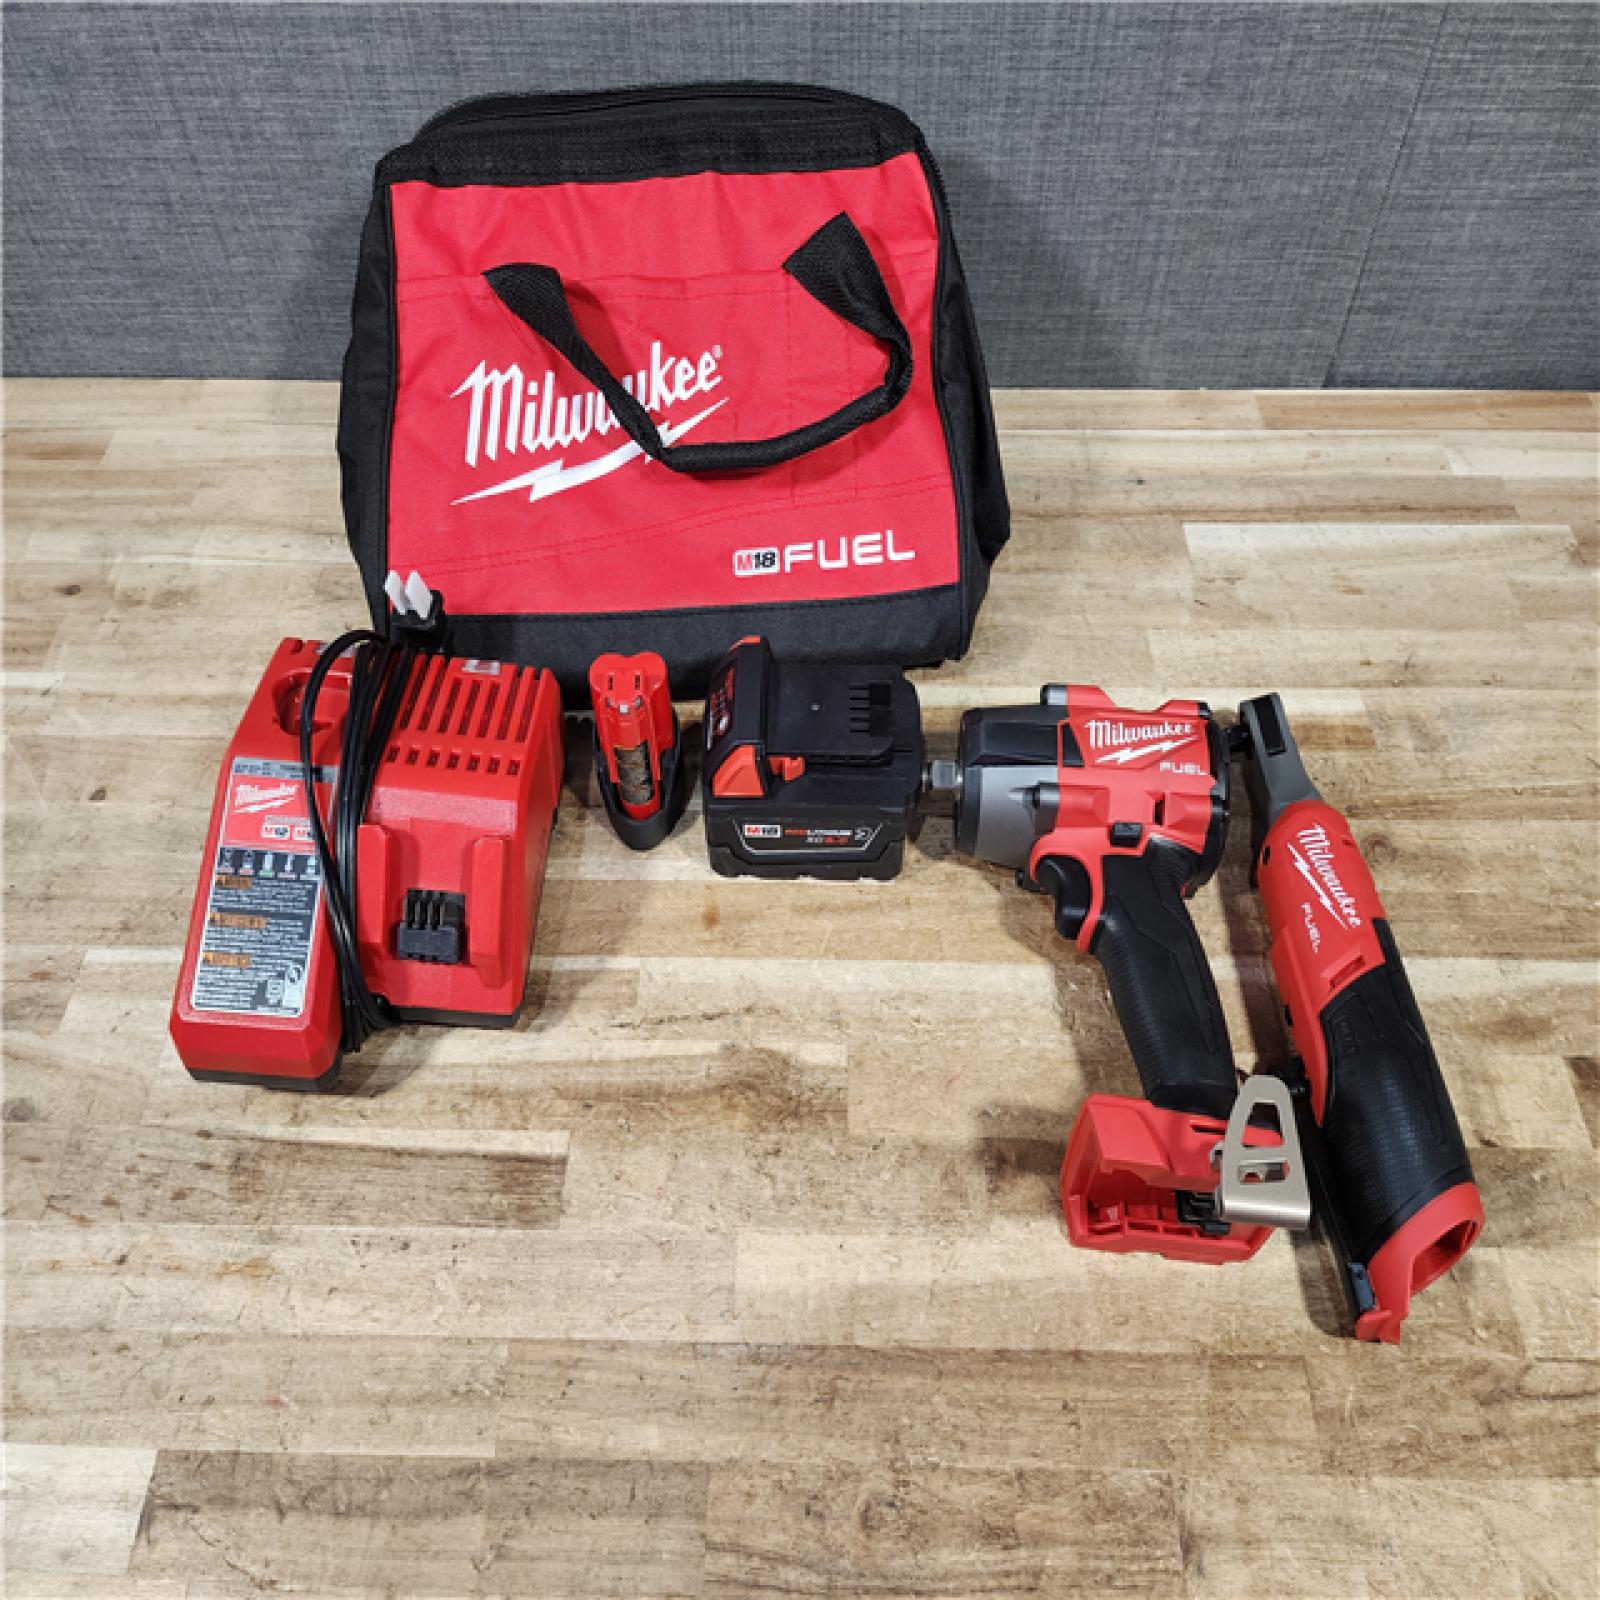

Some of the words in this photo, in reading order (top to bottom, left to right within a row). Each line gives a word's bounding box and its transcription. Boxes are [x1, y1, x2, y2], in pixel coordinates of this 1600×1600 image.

[734, 549, 778, 574] M18
[783, 530, 915, 572] FUEL
[1085, 719, 1195, 750] Milwaukee
[1159, 761, 1207, 776] FUEL
[1297, 823, 1361, 928] Milwaukee
[1302, 902, 1321, 954] FUEL
